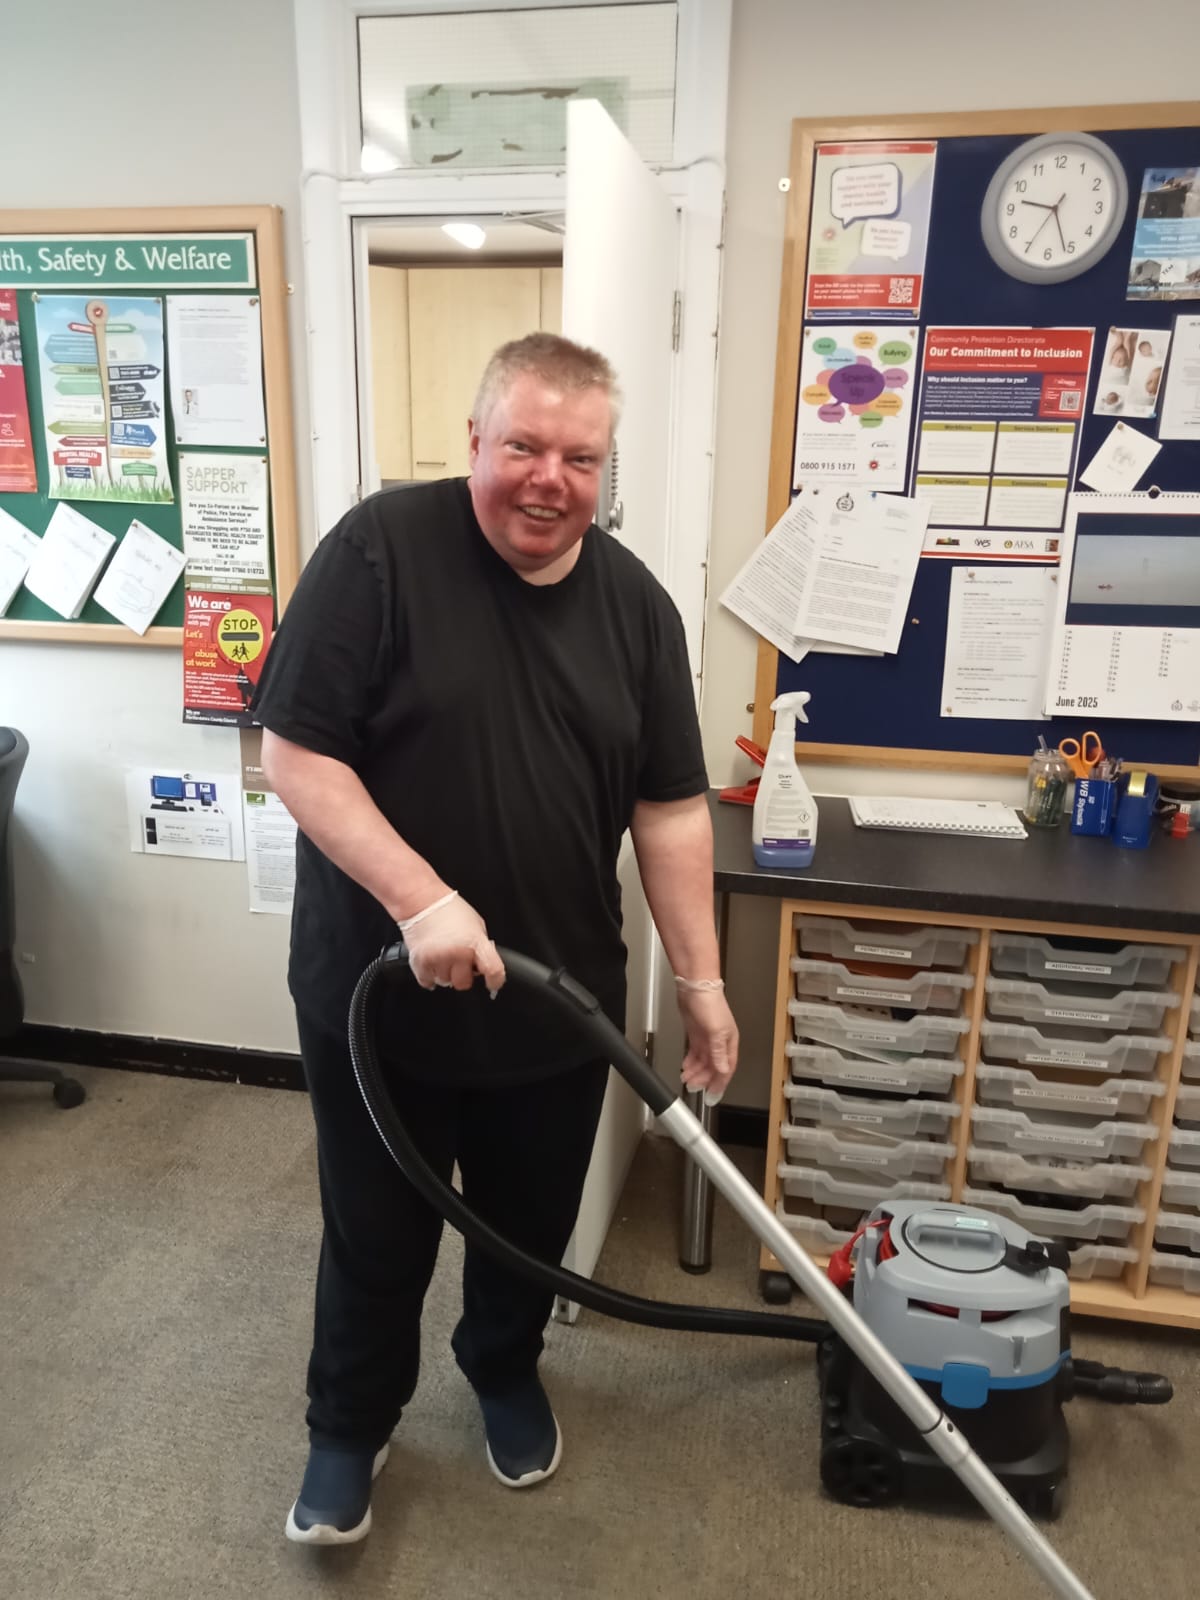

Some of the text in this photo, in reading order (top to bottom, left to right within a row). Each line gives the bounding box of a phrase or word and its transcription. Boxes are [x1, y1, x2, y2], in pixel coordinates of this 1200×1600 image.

[1054, 155, 1067, 168] 12
[1033, 164, 1044, 176] 11
[1080, 163, 1086, 174] 1
[1015, 180, 1027, 193] 10
[1092, 178, 1101, 191] 2
[1006, 204, 1015, 215] 9
[1095, 201, 1103, 214] 3
[1009, 226, 1017, 238] 8
[1085, 225, 1093, 237] 4
[1024, 242, 1032, 254] 7
[1067, 242, 1075, 254] 5
[1044, 249, 1052, 260] 6
[38, 246, 107, 277] Safety
[115, 247, 136, 271] &
[140, 245, 232, 271] Welfare
[931, 335, 1046, 344] Community Protection Directorate
[929, 346, 1083, 359] Our Commitment to Inclusion
[800, 461, 856, 471] 0800 915 1571
[186, 466, 236, 481] SAPPER
[186, 479, 248, 494] SUPPORT
[187, 595, 232, 610] We are
[223, 619, 258, 630] STOP
[194, 649, 218, 658] abuse
[185, 659, 217, 668] at work
[1055, 695, 1099, 708] June 2025
[1079, 780, 1090, 798] WB
